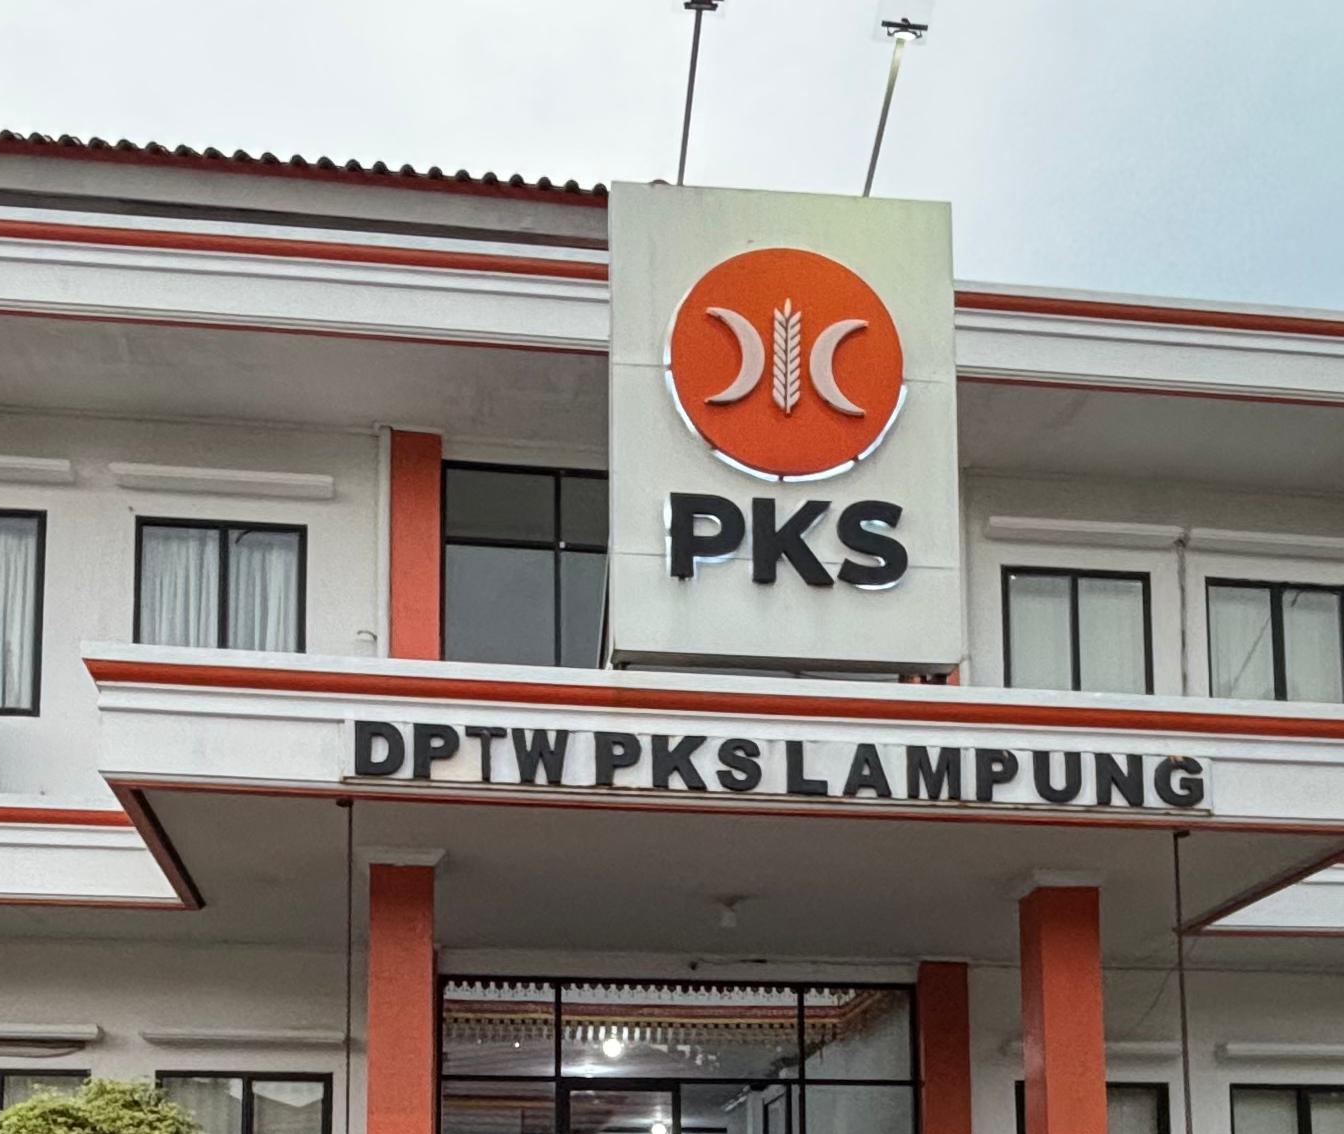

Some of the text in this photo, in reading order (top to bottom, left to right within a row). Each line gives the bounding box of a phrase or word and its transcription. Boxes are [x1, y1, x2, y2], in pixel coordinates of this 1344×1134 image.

[668, 491, 909, 588] PKS
[354, 719, 1204, 808] DPTW PKS LAMPUNG
